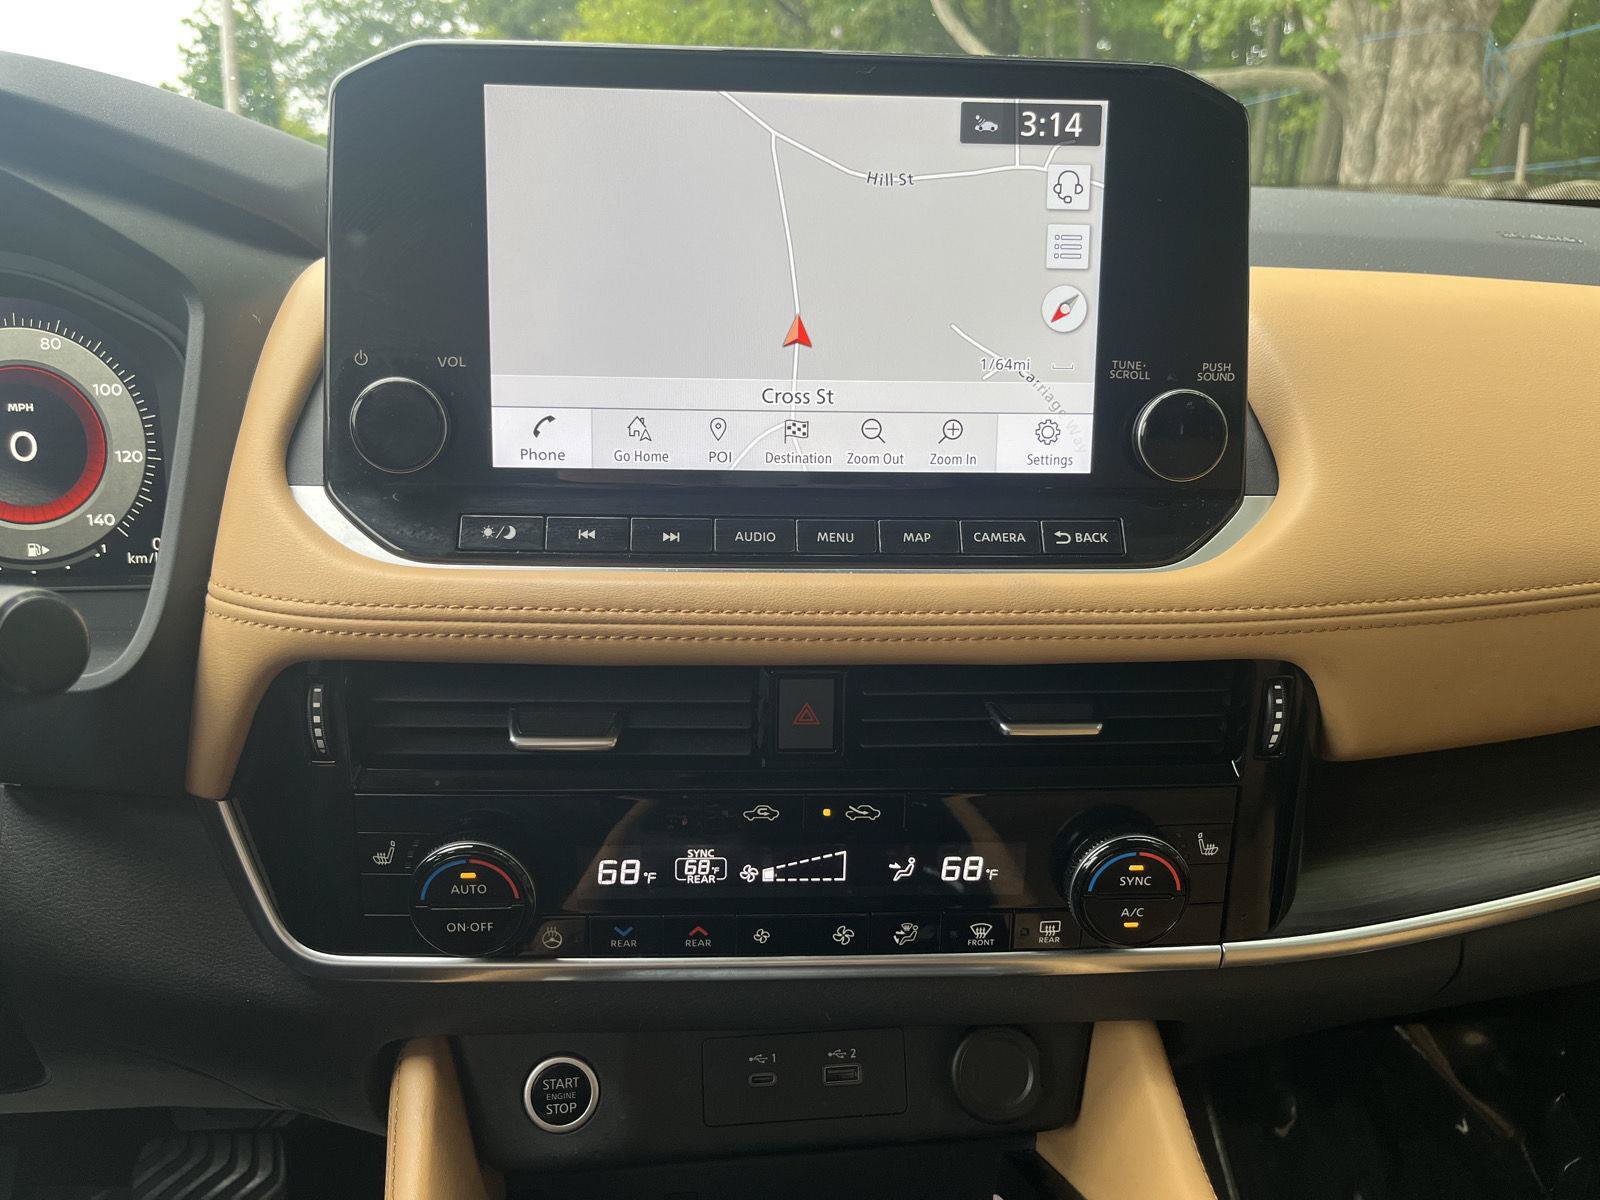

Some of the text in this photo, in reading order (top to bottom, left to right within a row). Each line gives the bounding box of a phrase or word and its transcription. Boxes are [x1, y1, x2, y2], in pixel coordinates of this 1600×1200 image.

[1020, 110, 1083, 138] 3:14
[866, 170, 915, 186] Hill St
[40, 337, 62, 351] 80
[437, 356, 466, 368] VOL
[980, 357, 1032, 373] 1/64mi
[1202, 362, 1232, 373] PUSH
[1109, 369, 1151, 380] SCROLL
[1197, 371, 1236, 382] SOUND
[92, 383, 123, 397] 100
[762, 387, 834, 406] Cross St
[7, 402, 34, 413] MPH
[9, 431, 38, 462] 0
[114, 450, 144, 464] 120
[520, 448, 566, 462] Phone
[613, 450, 669, 463] Go Home
[708, 451, 732, 464] POI
[765, 451, 832, 465] Destination
[846, 452, 904, 466] Zoom Out
[929, 453, 977, 466] Zoom In
[1026, 453, 1073, 469] Settings
[86, 513, 116, 527] 140
[734, 531, 776, 543] AUDIO
[816, 531, 855, 543] MENU
[902, 532, 931, 543] MAP
[973, 532, 1026, 543] CAMERA
[1074, 532, 1109, 543] BACK
[101, 543, 107, 554] 1
[687, 849, 715, 858] SYNC
[686, 874, 716, 884] REAR
[1119, 876, 1152, 887] SYNC
[451, 884, 487, 895] AUTO
[1120, 907, 1145, 918] A/C
[610, 939, 637, 948] REAR
[685, 938, 712, 948] REAR
[967, 938, 995, 947] FRONT
[1038, 936, 1061, 944] REAR
[771, 1053, 777, 1063] 1
[850, 1048, 857, 1059] 2
[542, 1077, 579, 1090] START
[546, 1092, 577, 1101] ENGINE
[546, 1102, 577, 1115] STOP
